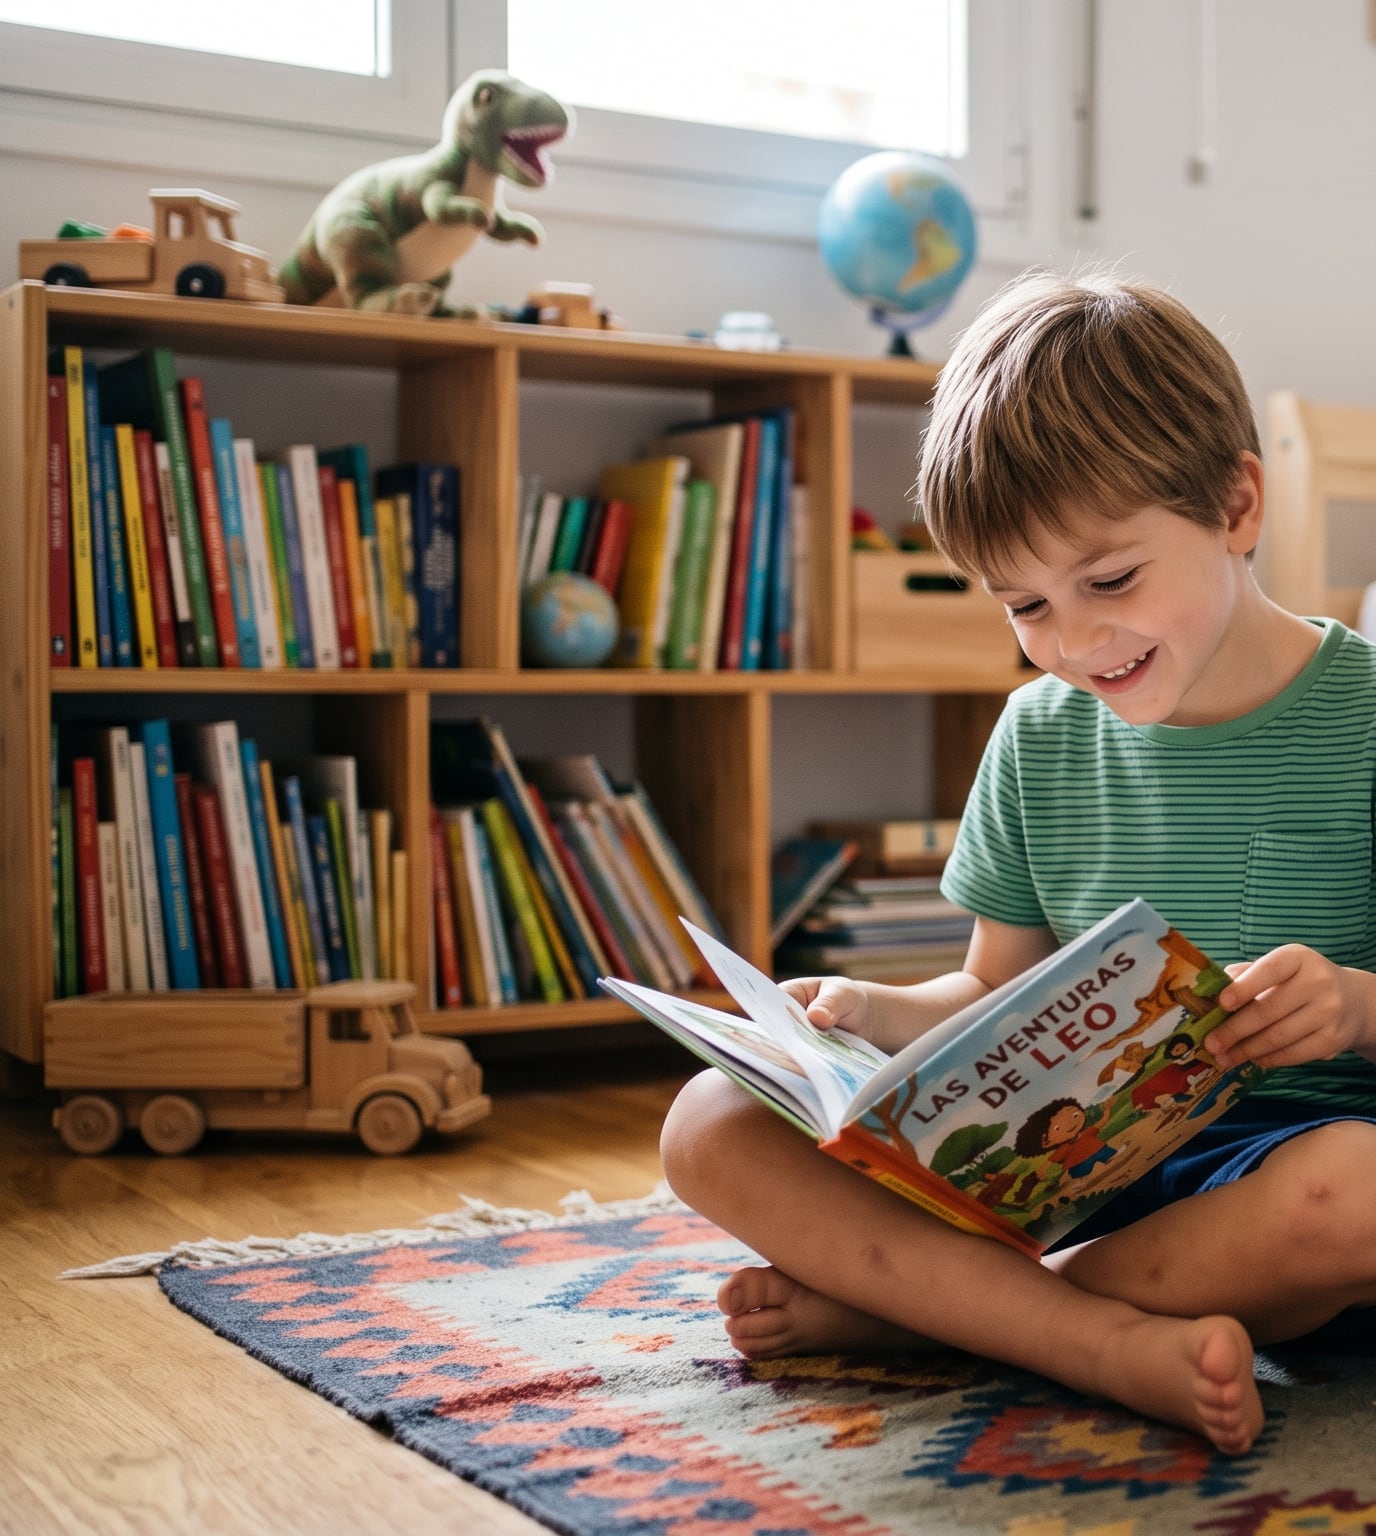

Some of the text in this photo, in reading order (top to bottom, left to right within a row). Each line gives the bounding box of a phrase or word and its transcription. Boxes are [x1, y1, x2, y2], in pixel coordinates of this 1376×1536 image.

[911, 951, 1137, 1124] LAS AVENTURAS
[978, 1002, 1117, 1110] DE LEO
